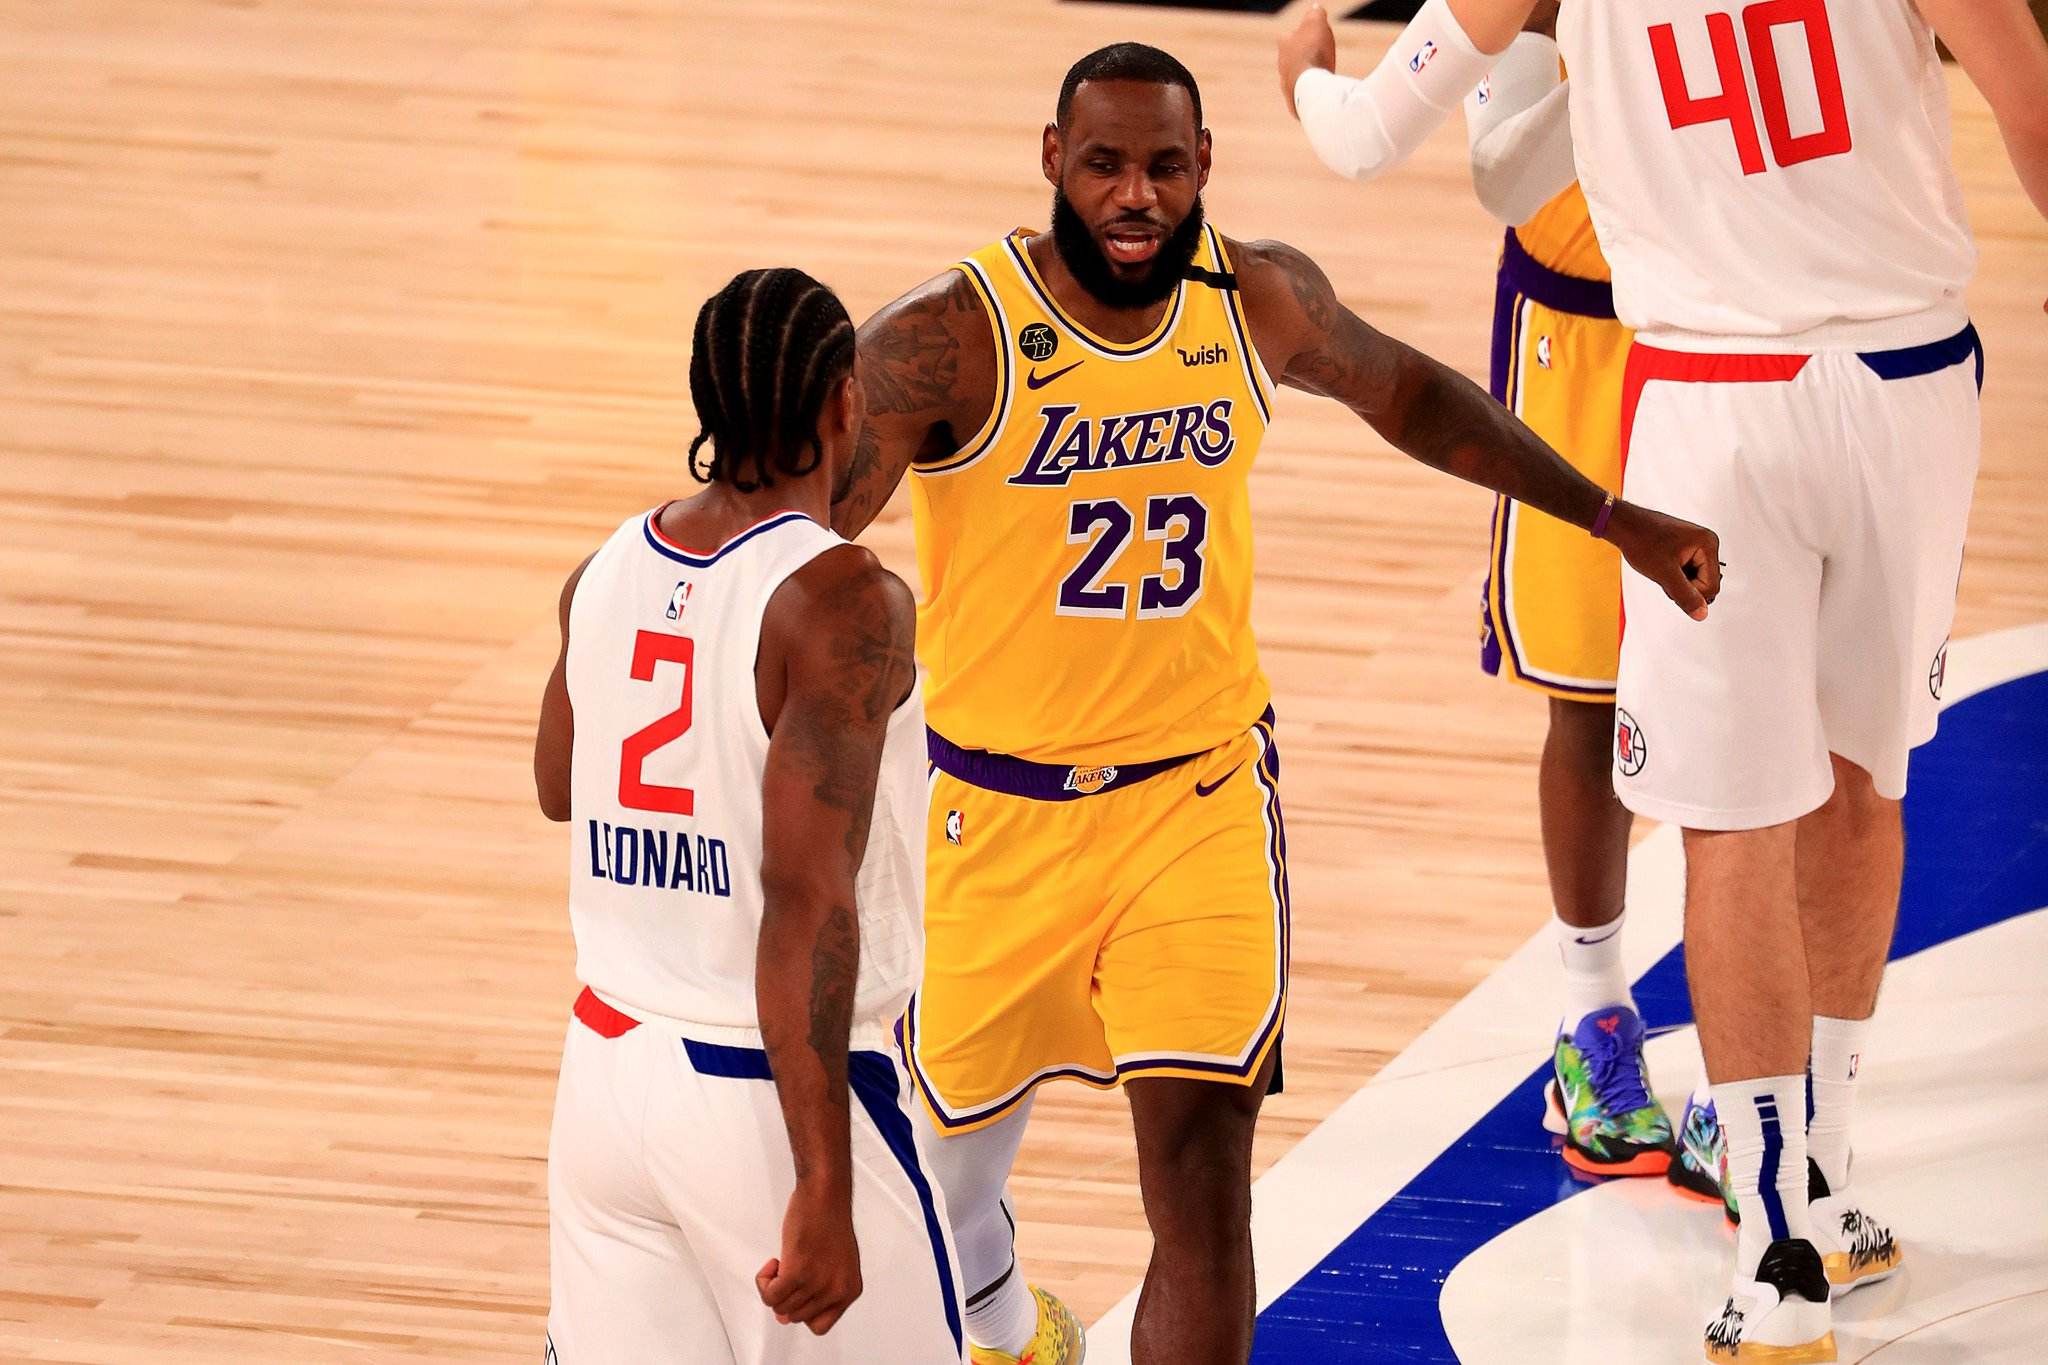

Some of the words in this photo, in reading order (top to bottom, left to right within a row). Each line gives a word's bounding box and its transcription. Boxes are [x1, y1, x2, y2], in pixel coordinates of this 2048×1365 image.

[1647, 0, 1852, 176] 40
[1176, 342, 1229, 368] wish
[1004, 399, 1236, 488] LAKERS
[1055, 493, 1209, 620] 23
[618, 629, 695, 817] 2
[1063, 766, 1119, 791] LAKERS
